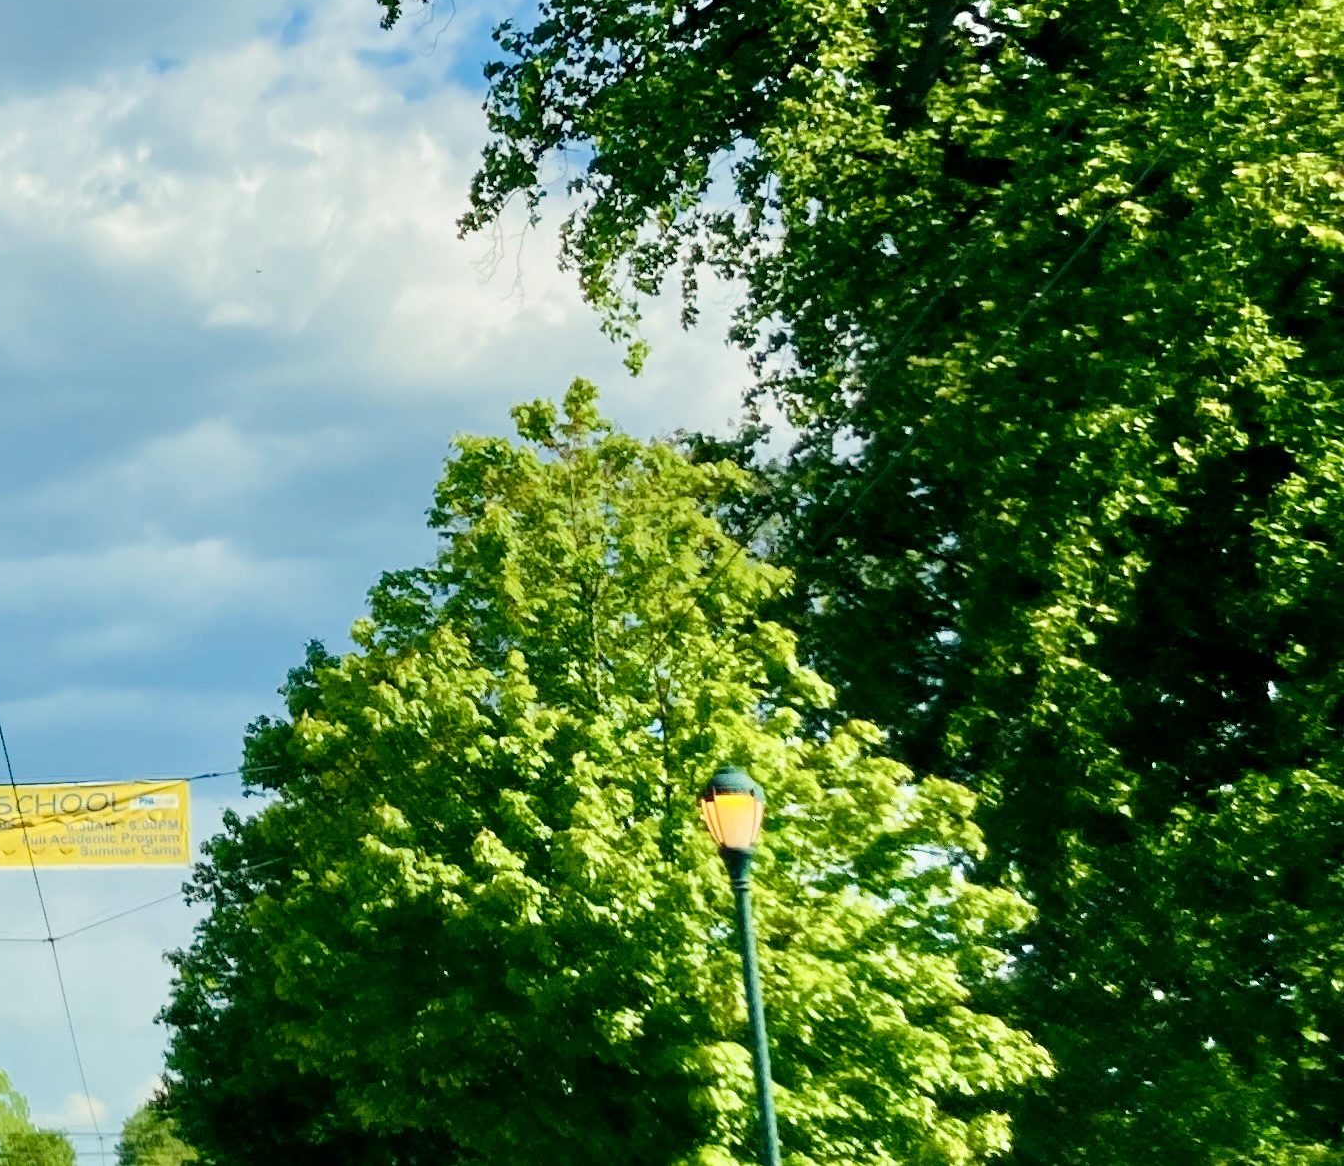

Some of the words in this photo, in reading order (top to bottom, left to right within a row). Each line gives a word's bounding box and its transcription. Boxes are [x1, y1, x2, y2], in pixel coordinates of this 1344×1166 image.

[22, 834, 47, 845] Full
[49, 833, 118, 844] Academic
[121, 832, 180, 847] Program
[79, 846, 137, 857] Summer
[141, 845, 181, 857] Camp
